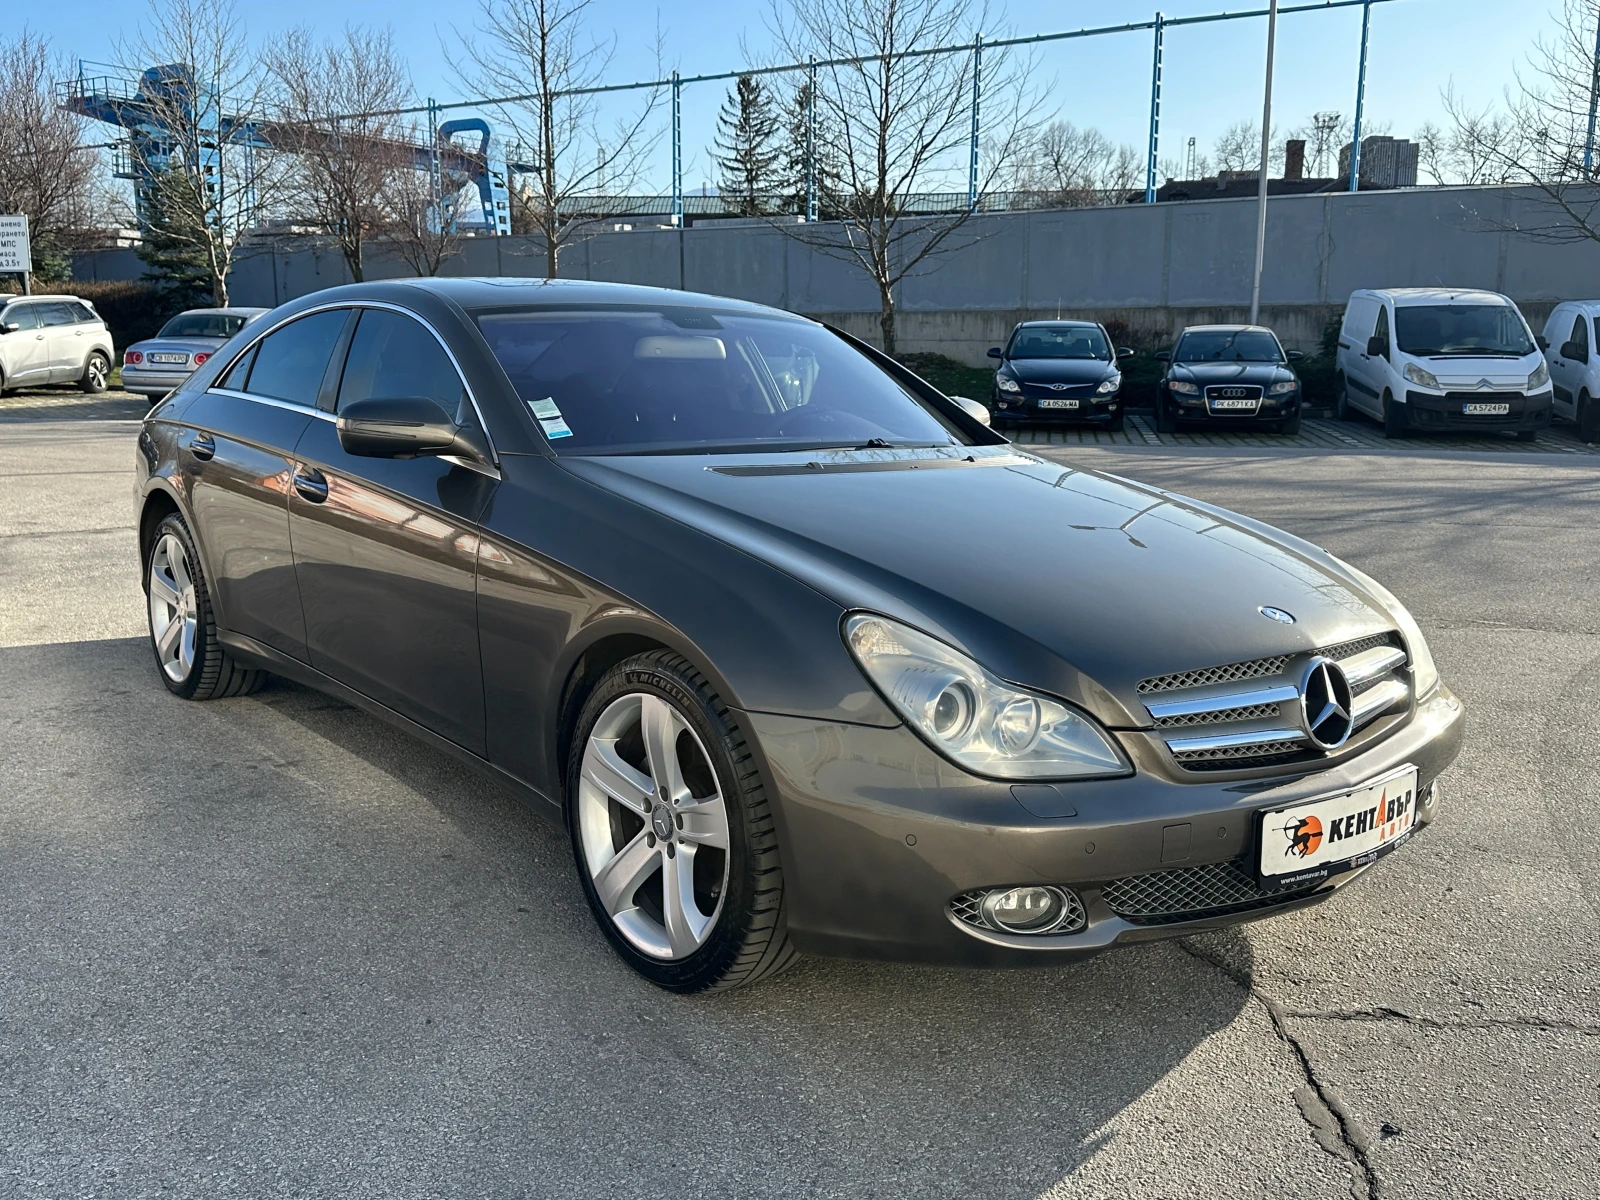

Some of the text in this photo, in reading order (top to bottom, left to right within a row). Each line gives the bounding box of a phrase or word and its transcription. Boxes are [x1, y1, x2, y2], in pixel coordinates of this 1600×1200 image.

[1, 240, 17, 248] МПС
[640, 673, 691, 708] MICHELIN
[1280, 868, 1328, 885] www.kentavar.bg
